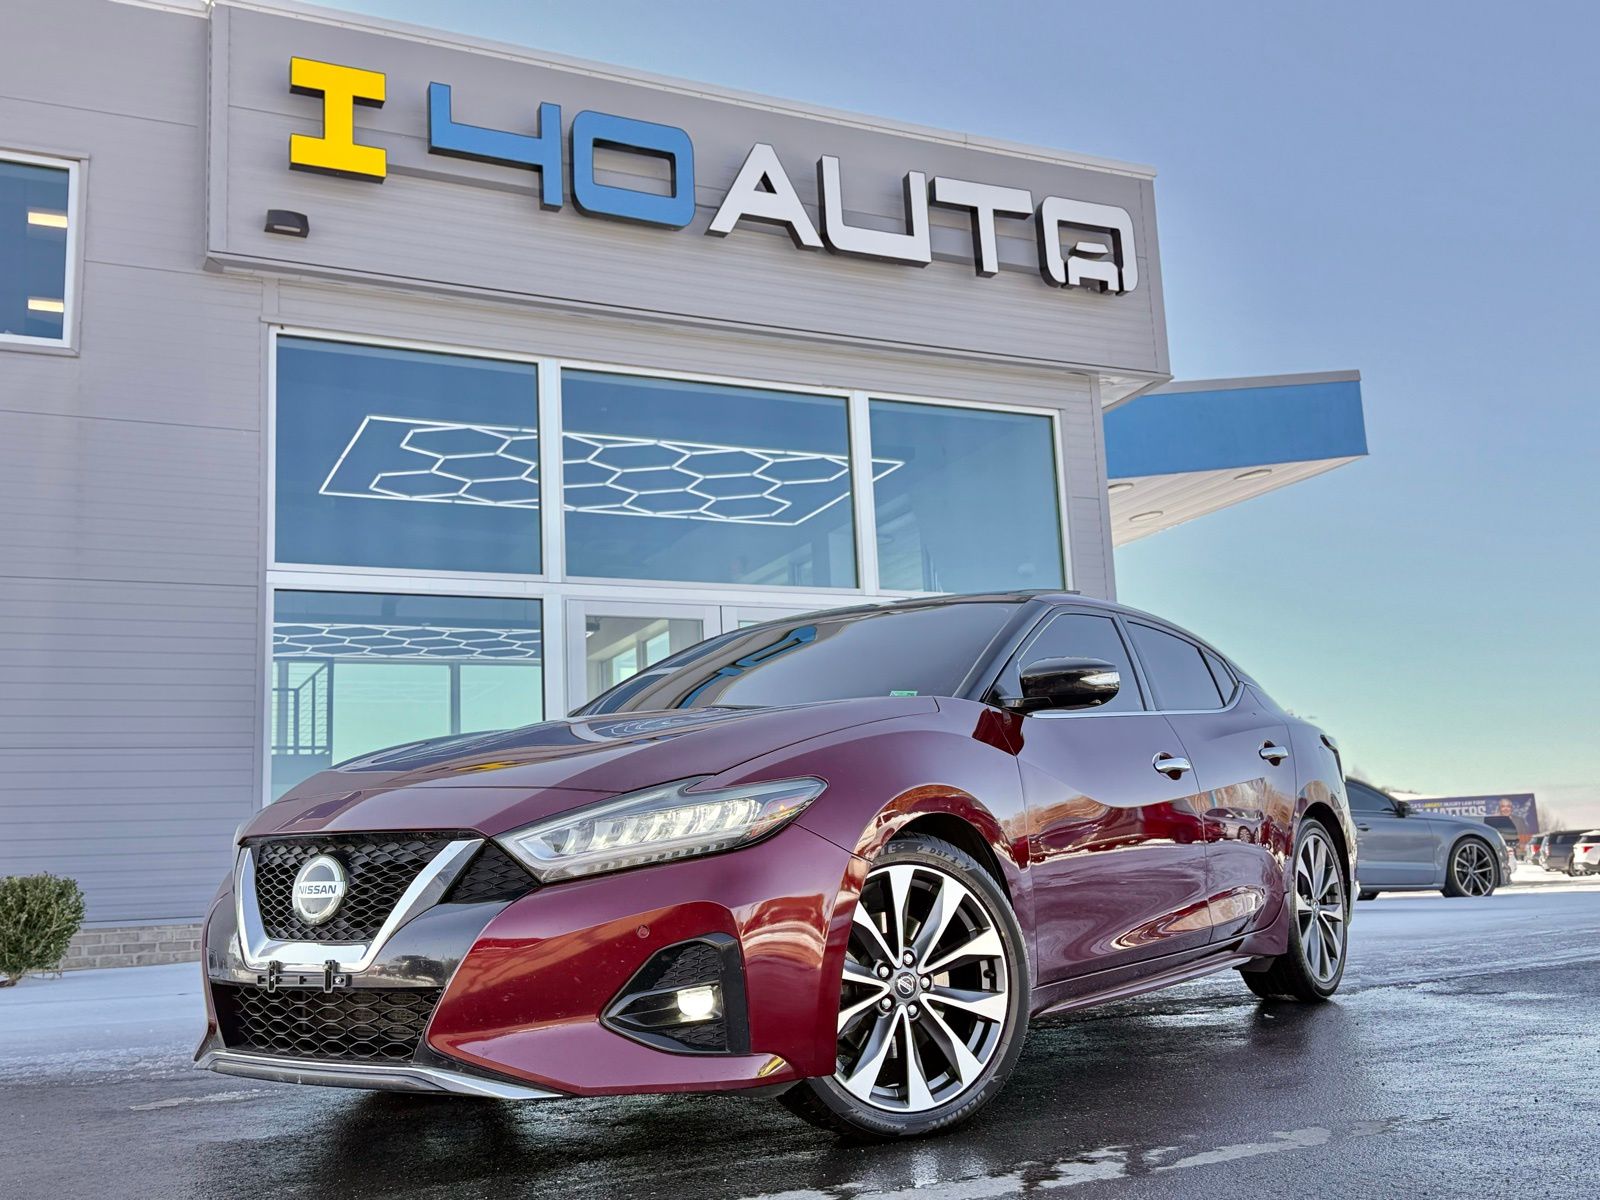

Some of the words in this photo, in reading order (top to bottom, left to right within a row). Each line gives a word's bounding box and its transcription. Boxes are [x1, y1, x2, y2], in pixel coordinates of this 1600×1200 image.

[290, 56, 387, 182] I
[428, 81, 696, 230] 40
[298, 884, 337, 895] NISSAN
